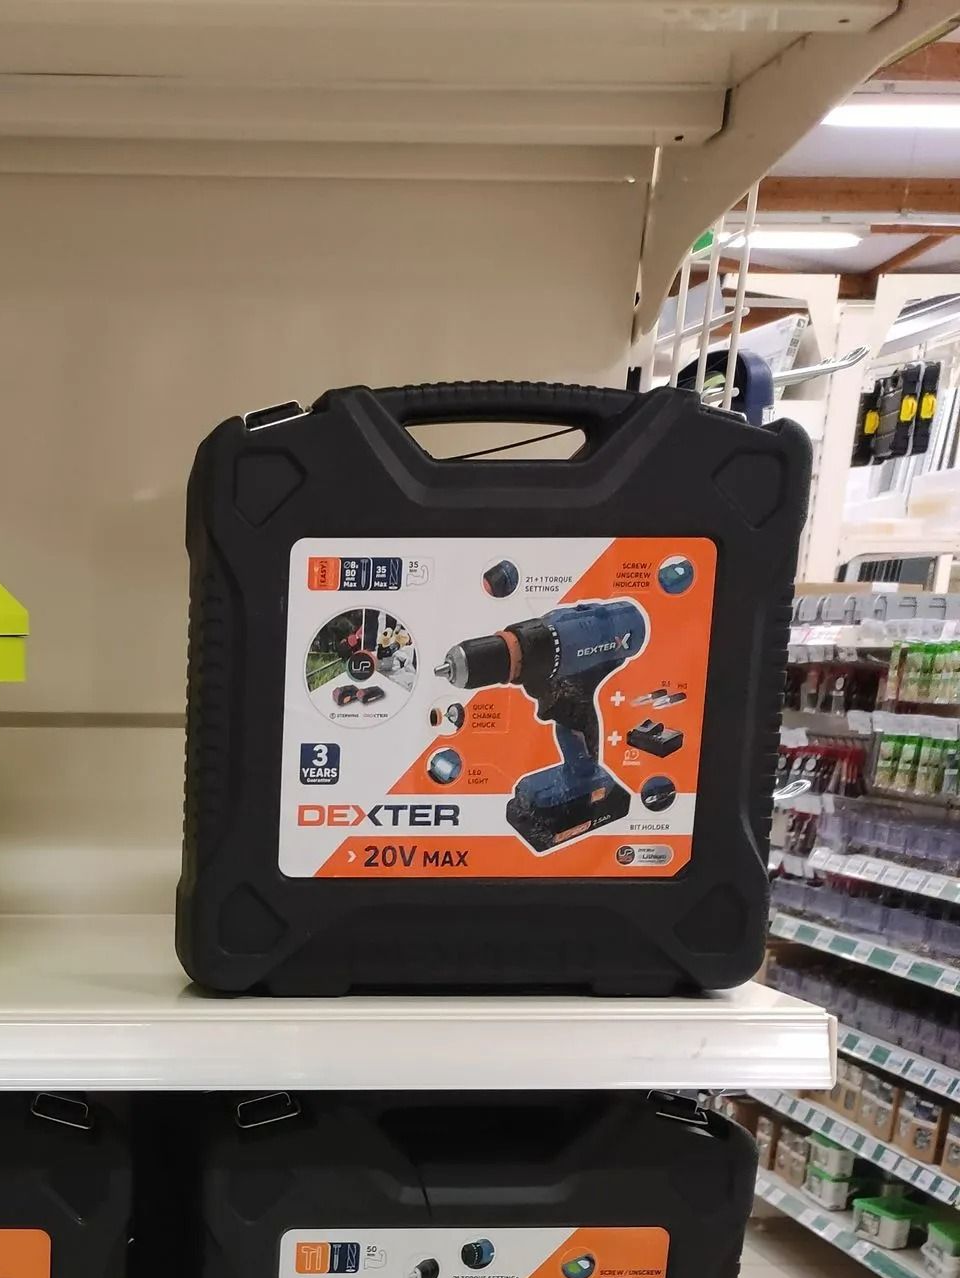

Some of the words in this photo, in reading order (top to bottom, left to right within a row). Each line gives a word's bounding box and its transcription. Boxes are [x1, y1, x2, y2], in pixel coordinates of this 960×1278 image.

[345, 569, 356, 577] 80
[375, 565, 387, 573] 35
[311, 744, 328, 767] 3
[302, 768, 337, 778] YEARS
[297, 804, 460, 827] DEXTER
[363, 845, 418, 868] 20V
[422, 850, 469, 868] MAX
[366, 1245, 377, 1253] 50
